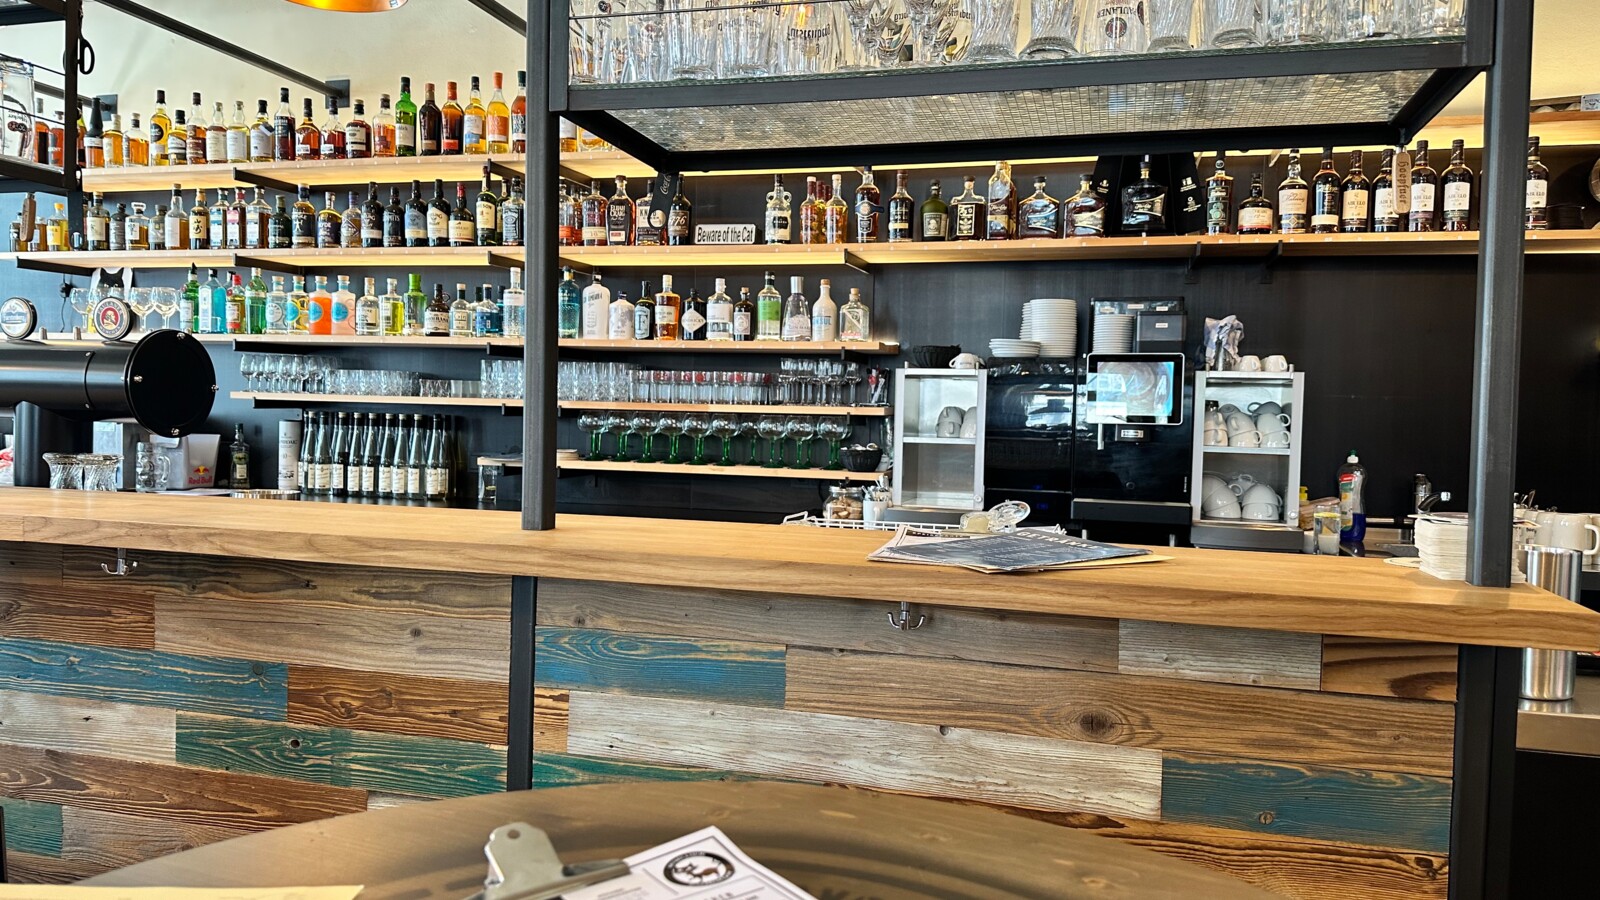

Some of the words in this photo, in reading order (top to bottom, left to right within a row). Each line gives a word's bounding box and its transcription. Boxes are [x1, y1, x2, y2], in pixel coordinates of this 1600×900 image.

[640, 208, 657, 216] KNB
[697, 226, 721, 243] Beware
[722, 226, 730, 243] of
[730, 227, 741, 243] the
[741, 226, 754, 243] Cat
[188, 476, 200, 485] Red
[200, 475, 213, 484] Bull
[1016, 531, 1100, 549] GETRÄNKE
